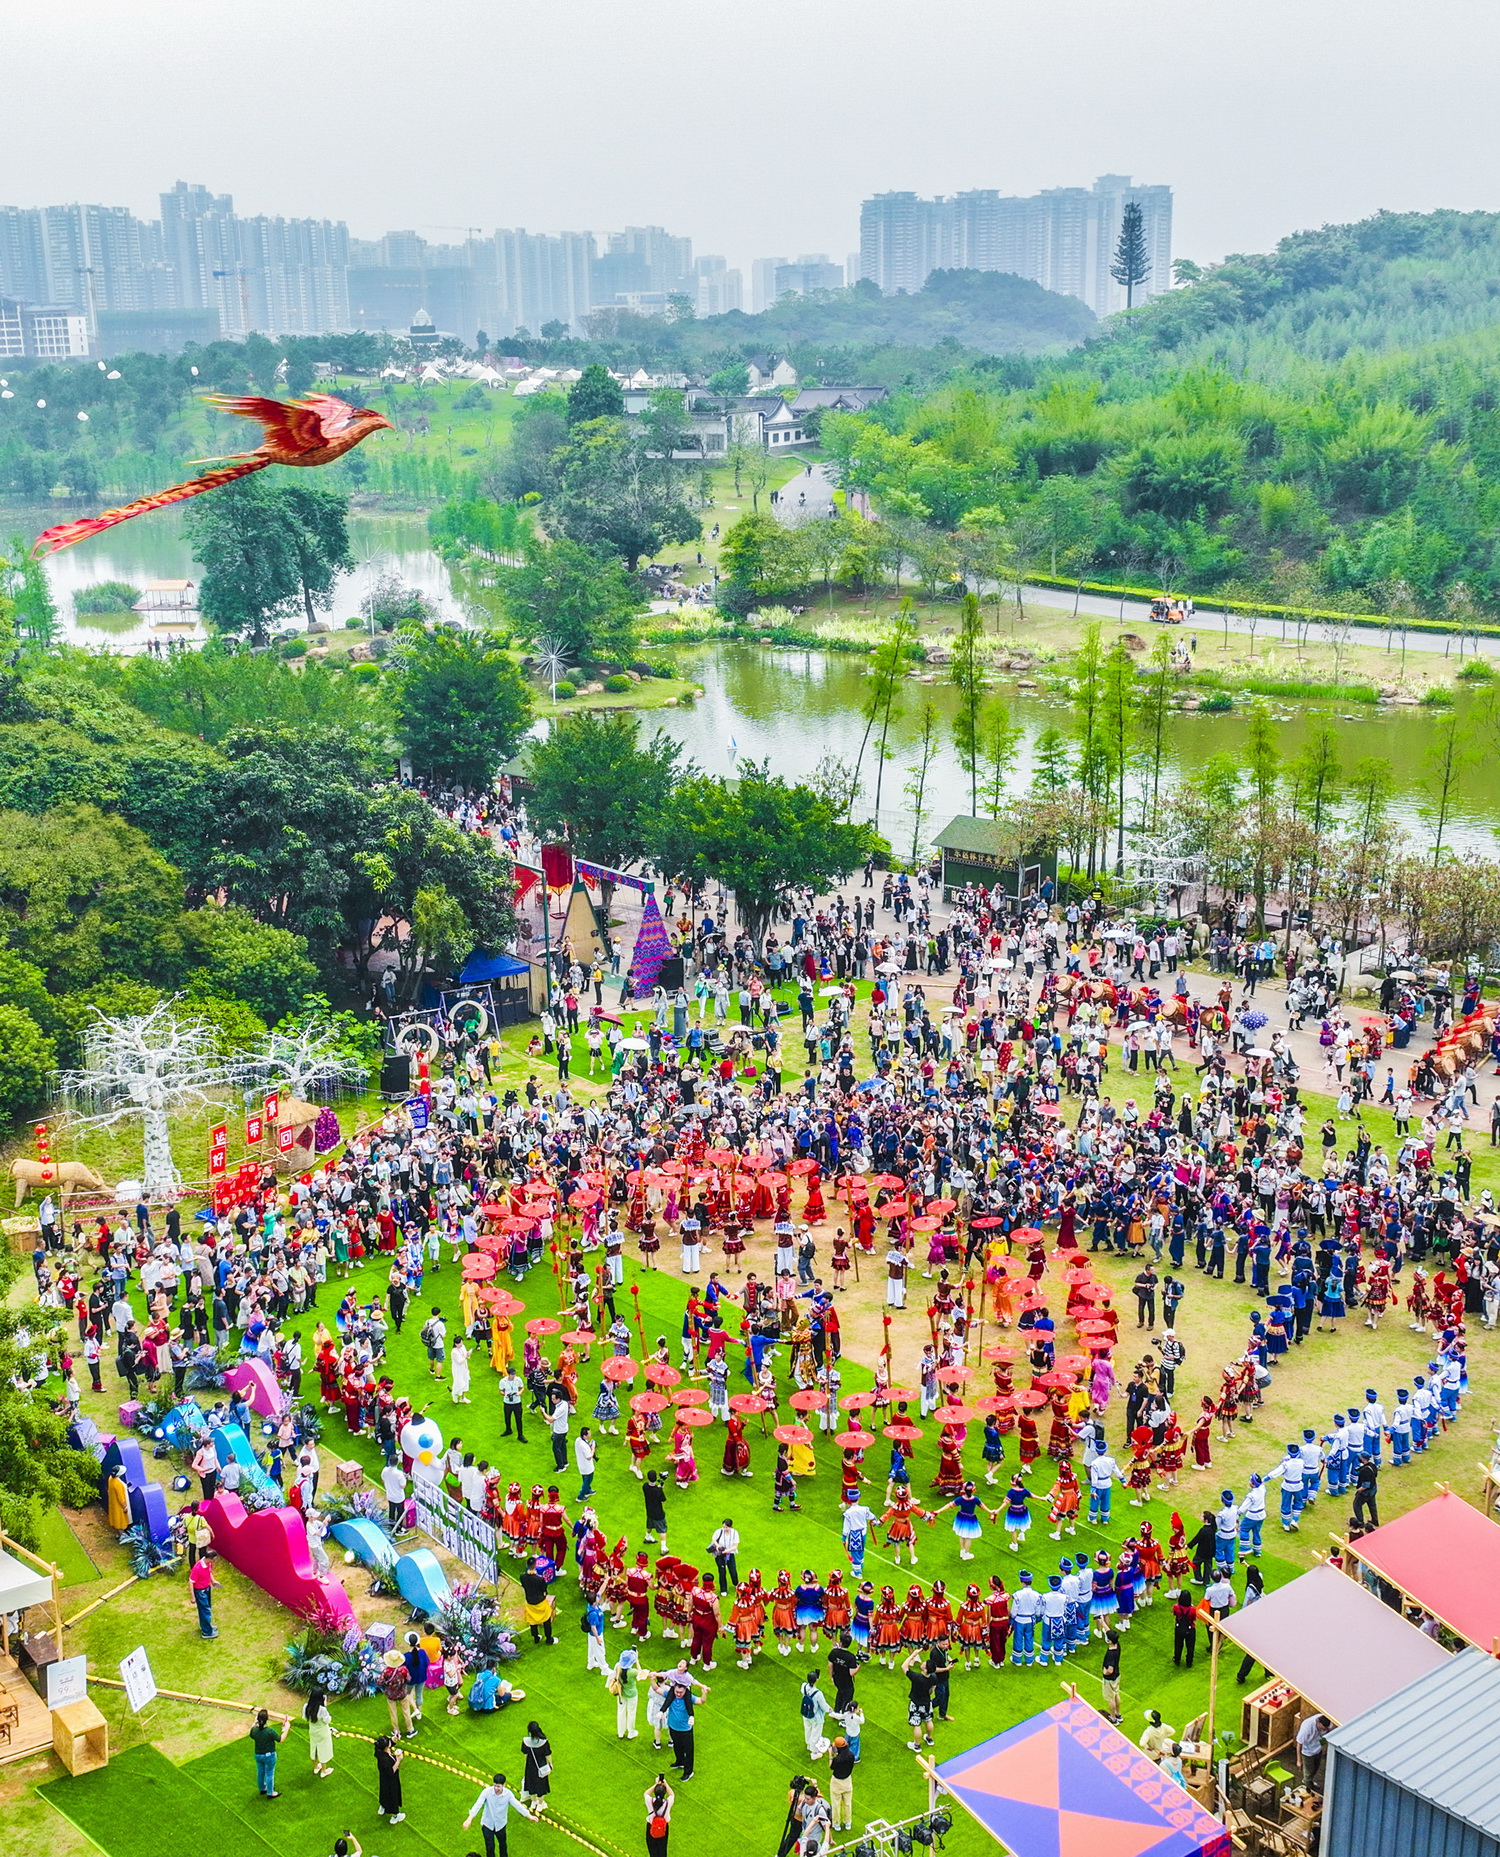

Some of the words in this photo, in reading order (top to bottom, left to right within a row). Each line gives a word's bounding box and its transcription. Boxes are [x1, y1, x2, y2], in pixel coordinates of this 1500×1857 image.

[249, 1121, 260, 1138] 带
[280, 1129, 293, 1147] 回
[212, 1152, 224, 1167] 好
